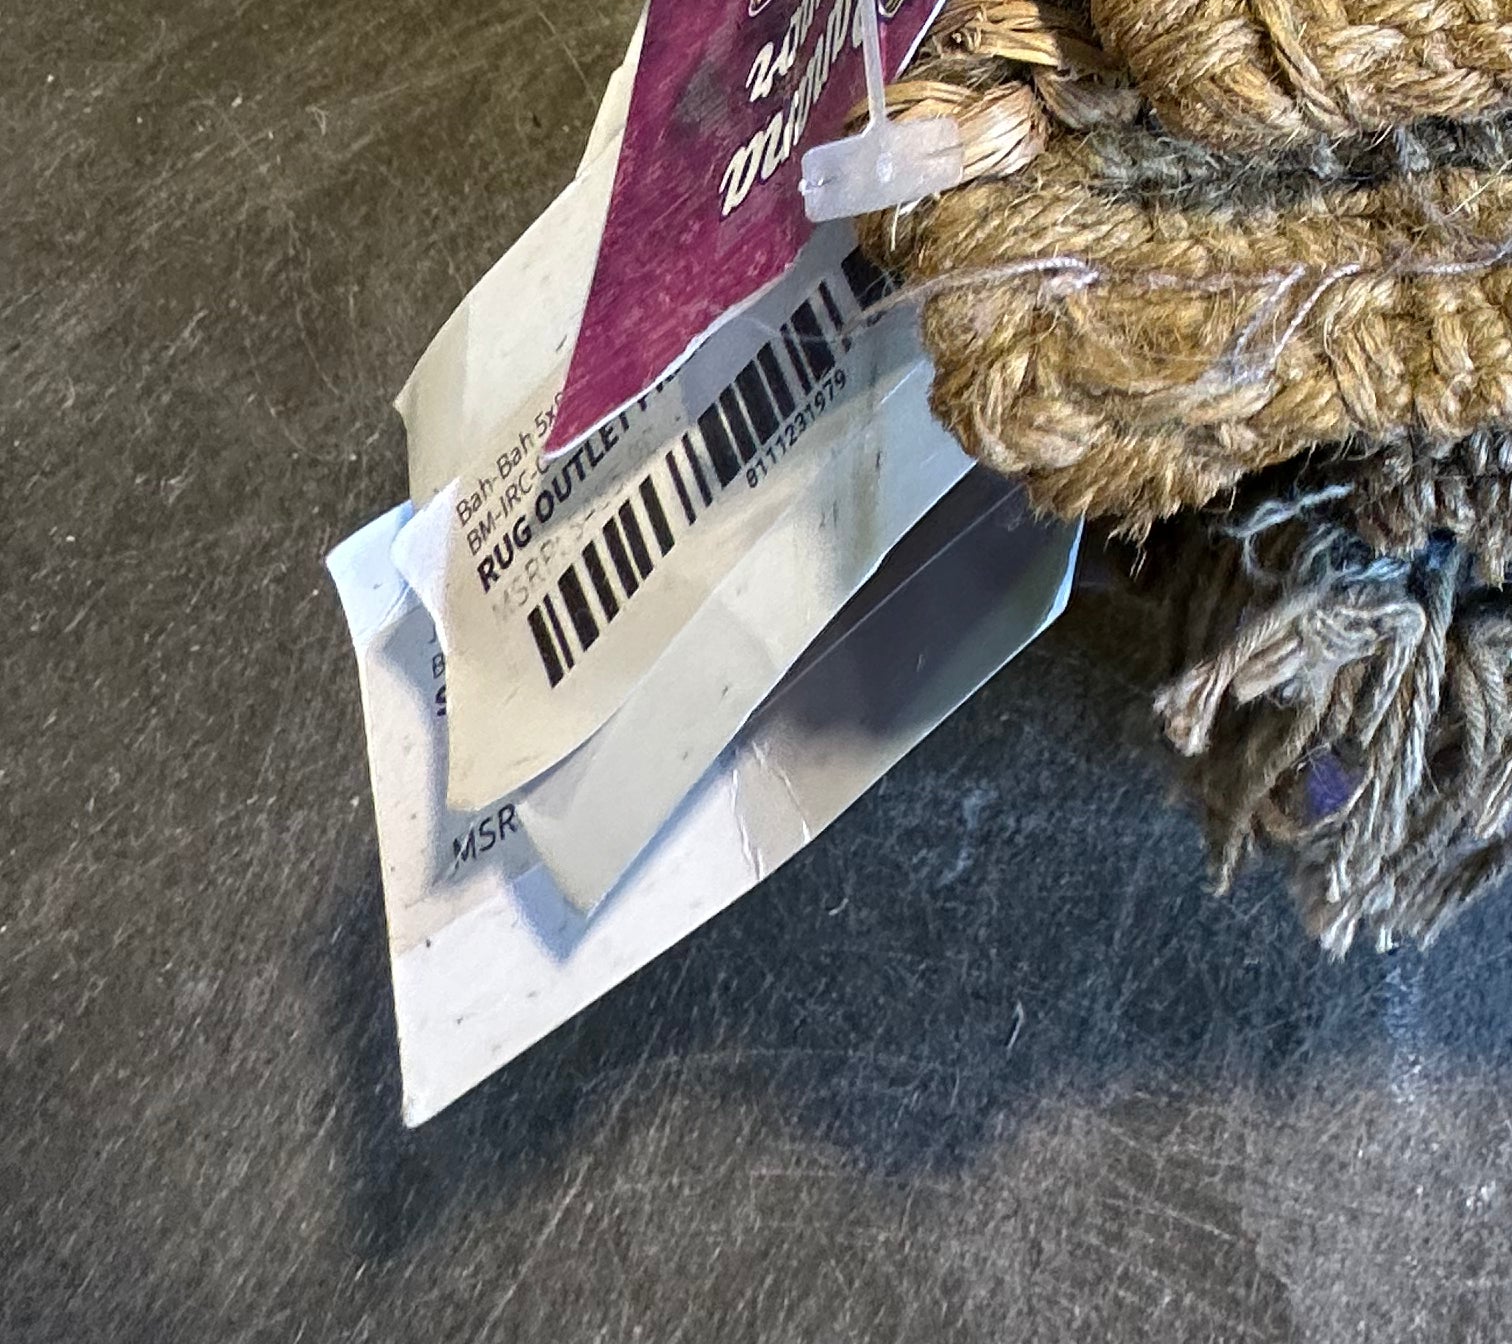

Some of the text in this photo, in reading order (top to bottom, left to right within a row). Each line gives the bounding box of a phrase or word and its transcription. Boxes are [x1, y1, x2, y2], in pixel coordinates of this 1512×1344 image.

[456, 391, 564, 527] Bah-Bah 5x
[745, 368, 847, 489] 8111231979
[476, 514, 533, 594] RUG
[452, 802, 518, 863] MSR
